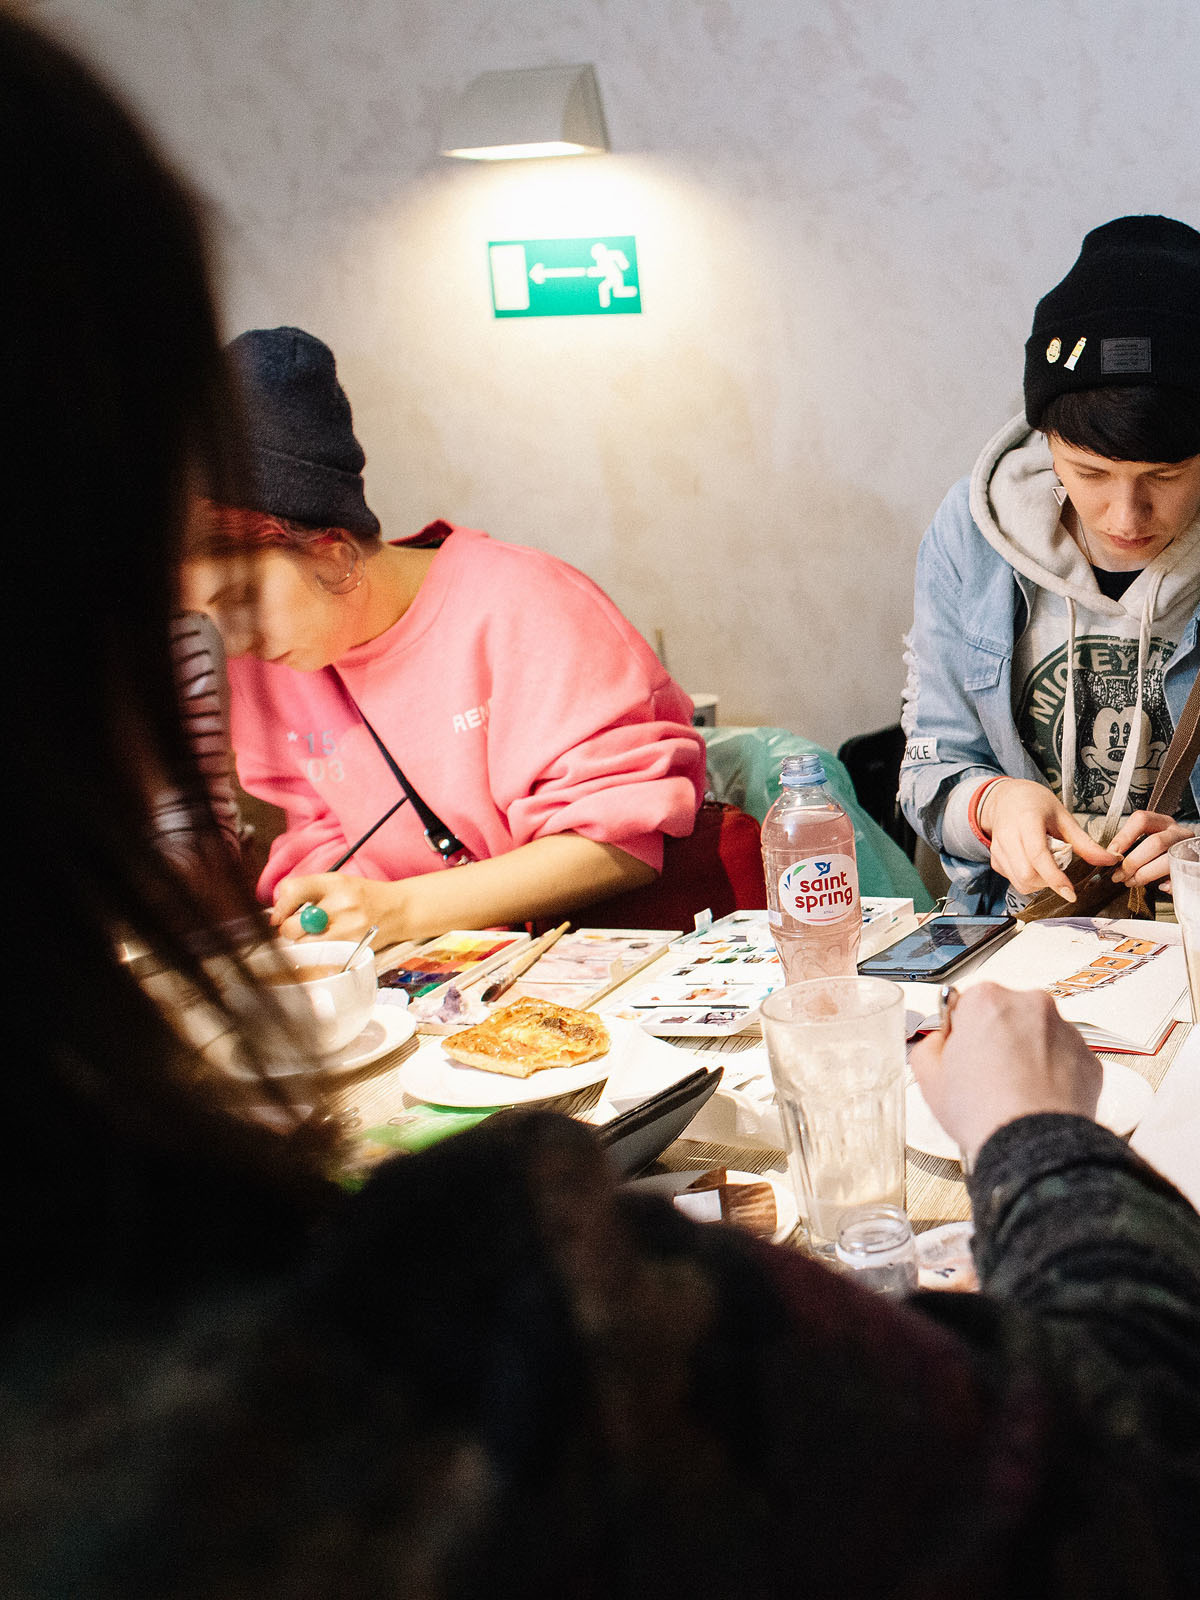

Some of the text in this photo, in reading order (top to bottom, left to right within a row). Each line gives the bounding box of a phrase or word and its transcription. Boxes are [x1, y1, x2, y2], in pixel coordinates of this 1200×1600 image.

[307, 758, 345, 783] 03
[800, 871, 848, 893] saint
[795, 887, 853, 913] spring
